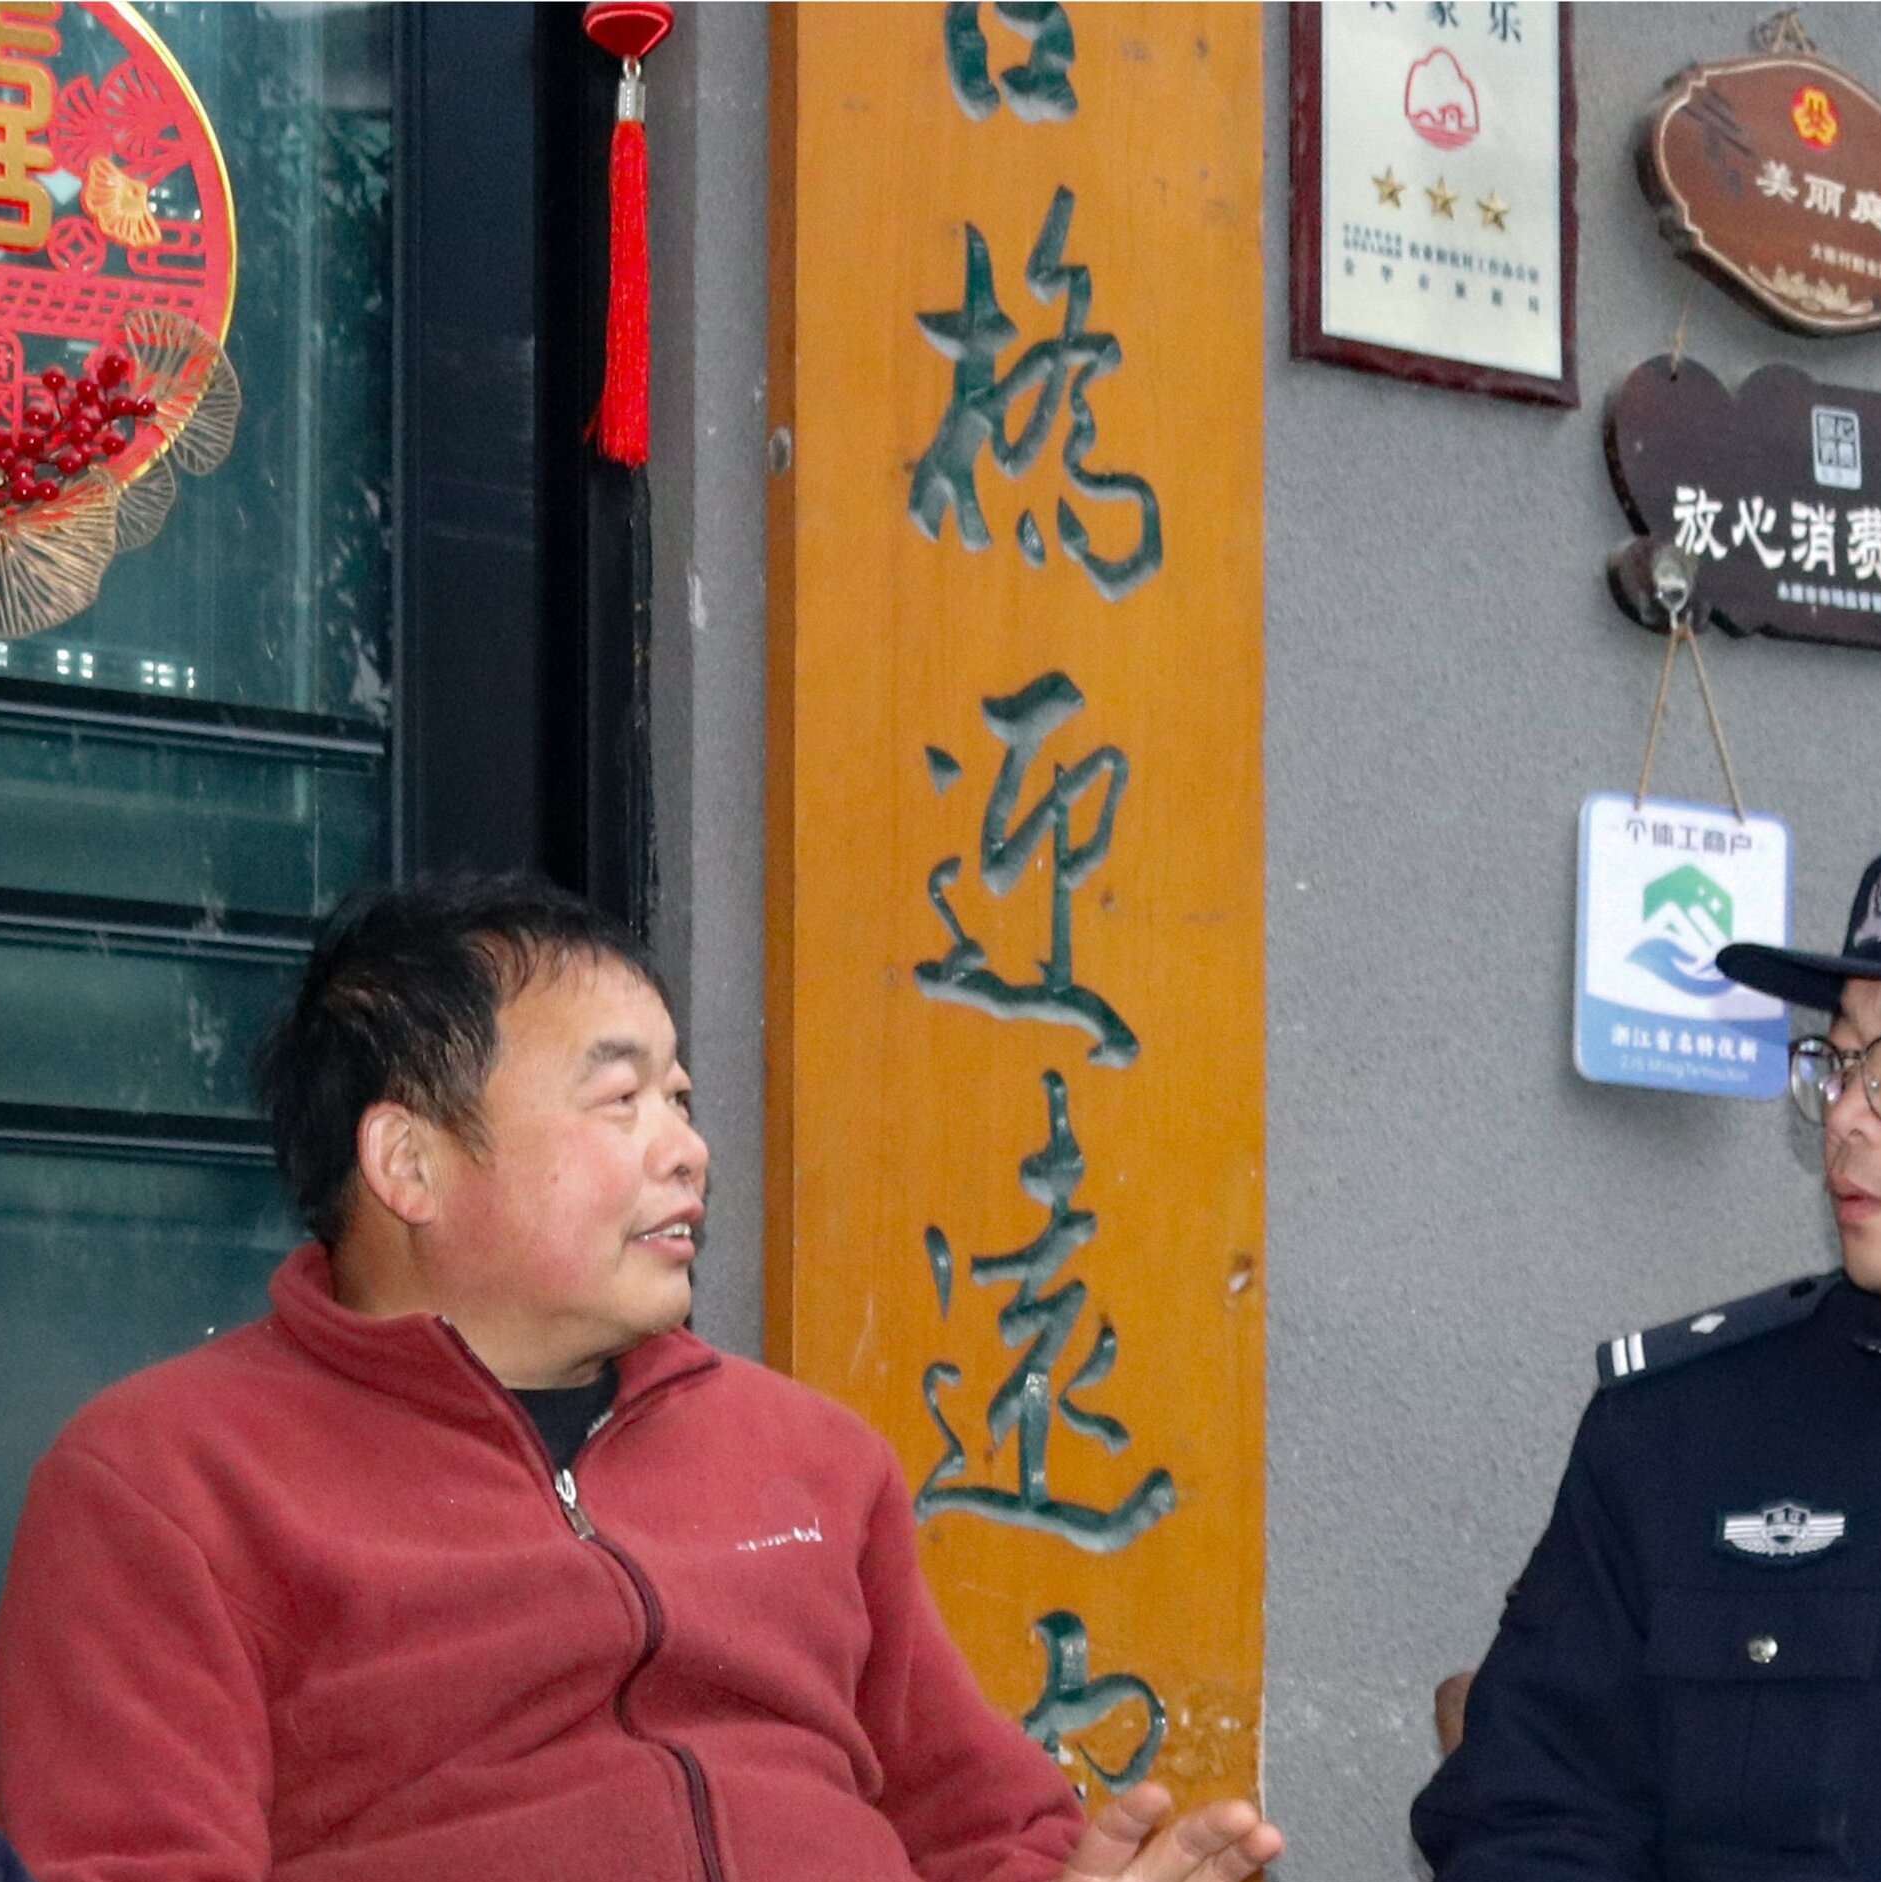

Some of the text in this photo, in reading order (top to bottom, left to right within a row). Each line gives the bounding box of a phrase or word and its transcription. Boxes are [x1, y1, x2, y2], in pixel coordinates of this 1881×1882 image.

[1624, 817, 1754, 857] 个体工商户
